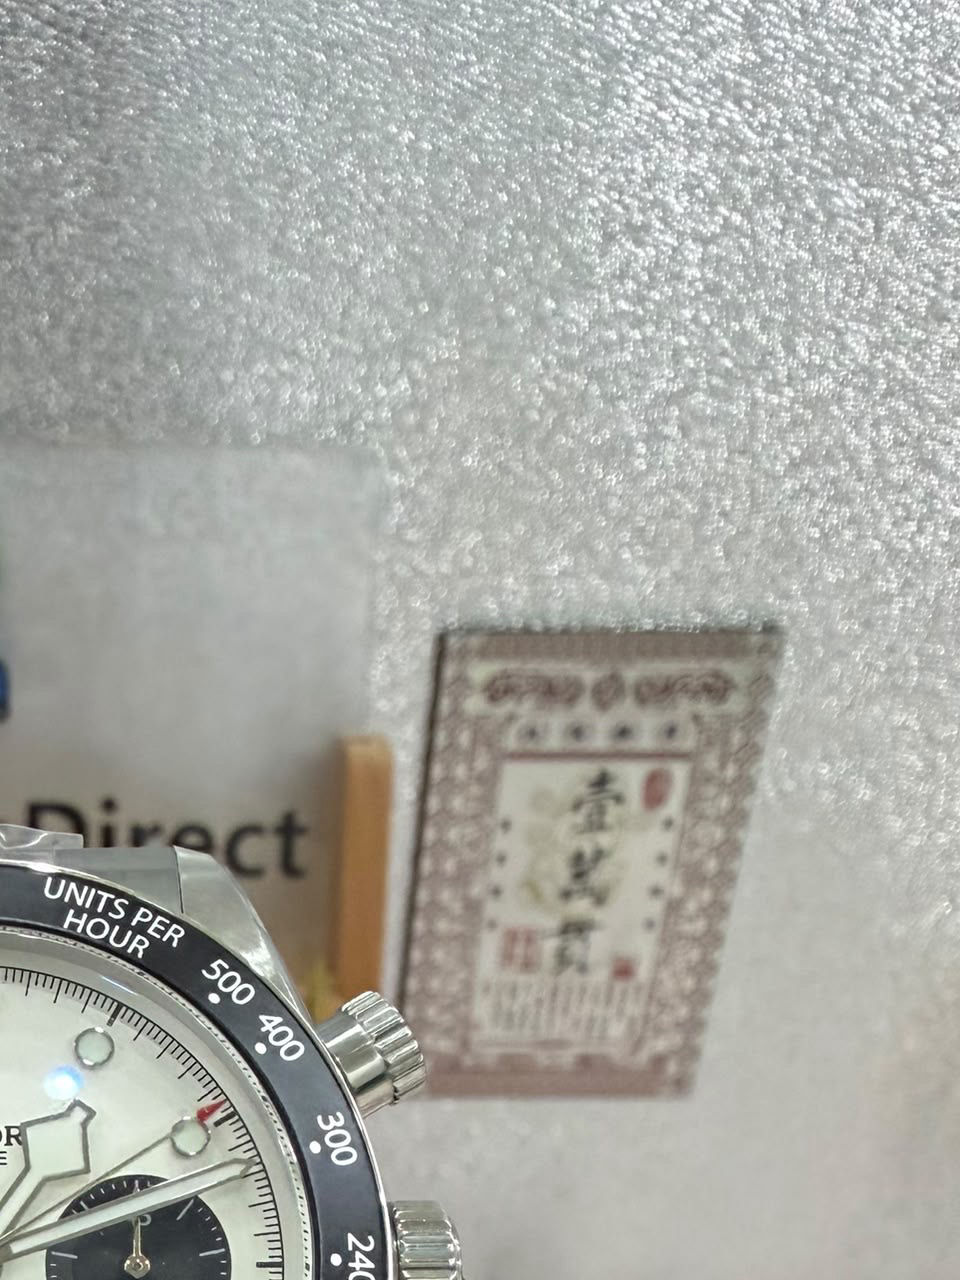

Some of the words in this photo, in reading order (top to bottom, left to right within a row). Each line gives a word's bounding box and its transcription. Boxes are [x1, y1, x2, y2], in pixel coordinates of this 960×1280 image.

[44, 877, 129, 920] UNITS
[131, 907, 185, 948] PER
[63, 909, 150, 958] HOUR
[201, 959, 255, 1005] 500
[258, 1014, 305, 1061] 400
[316, 1111, 358, 1166] 300
